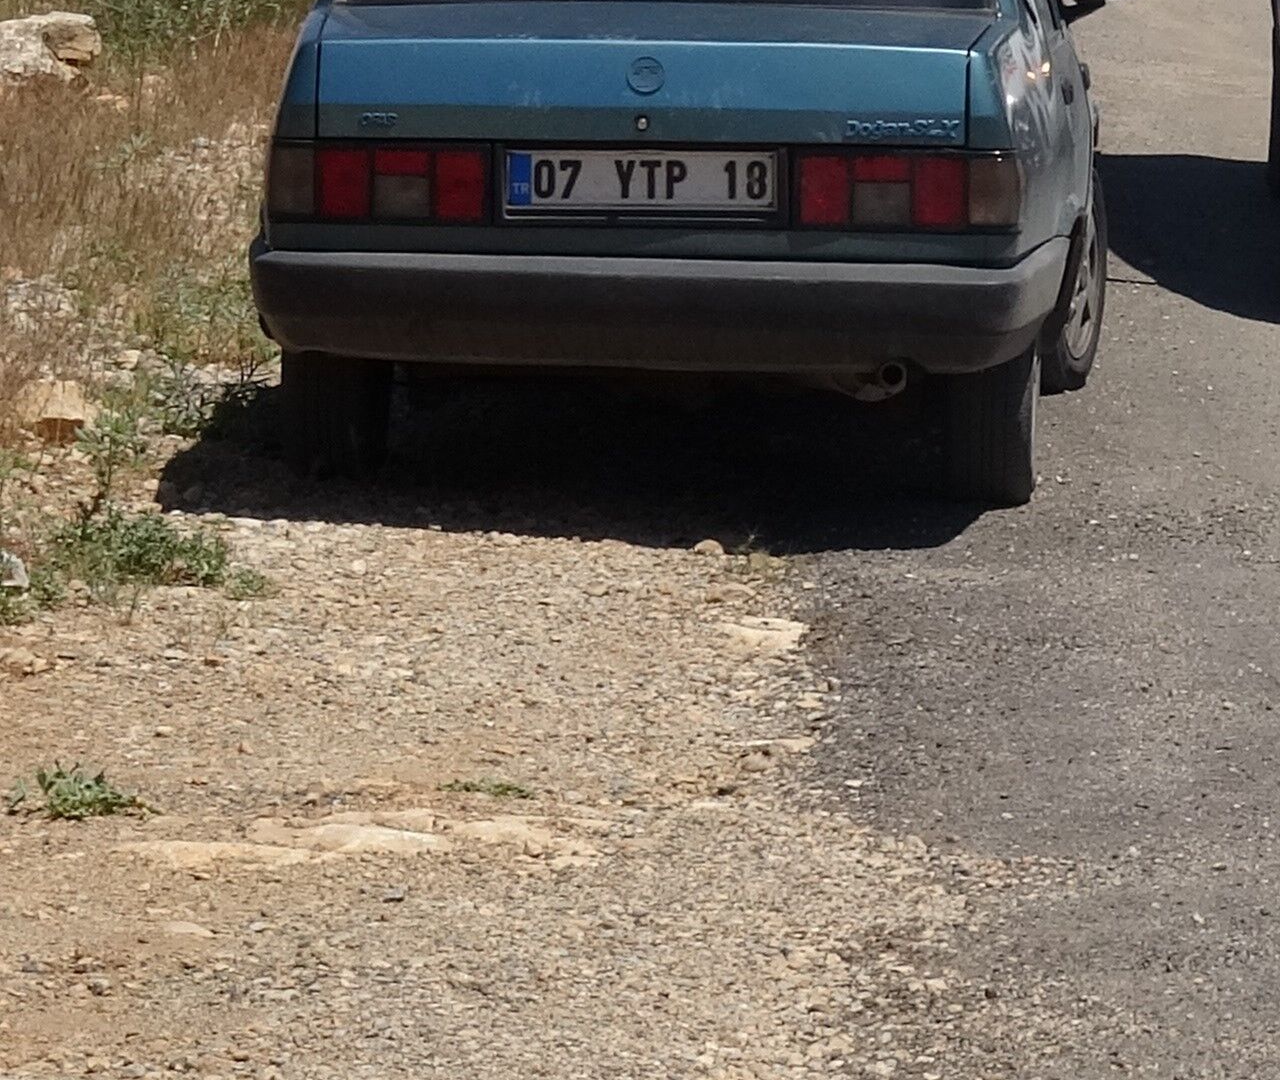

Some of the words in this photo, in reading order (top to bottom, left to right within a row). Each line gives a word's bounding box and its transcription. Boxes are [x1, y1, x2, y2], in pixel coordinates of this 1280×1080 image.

[533, 160, 582, 199] 07
[614, 160, 688, 200] YTP
[724, 160, 767, 200] 18
